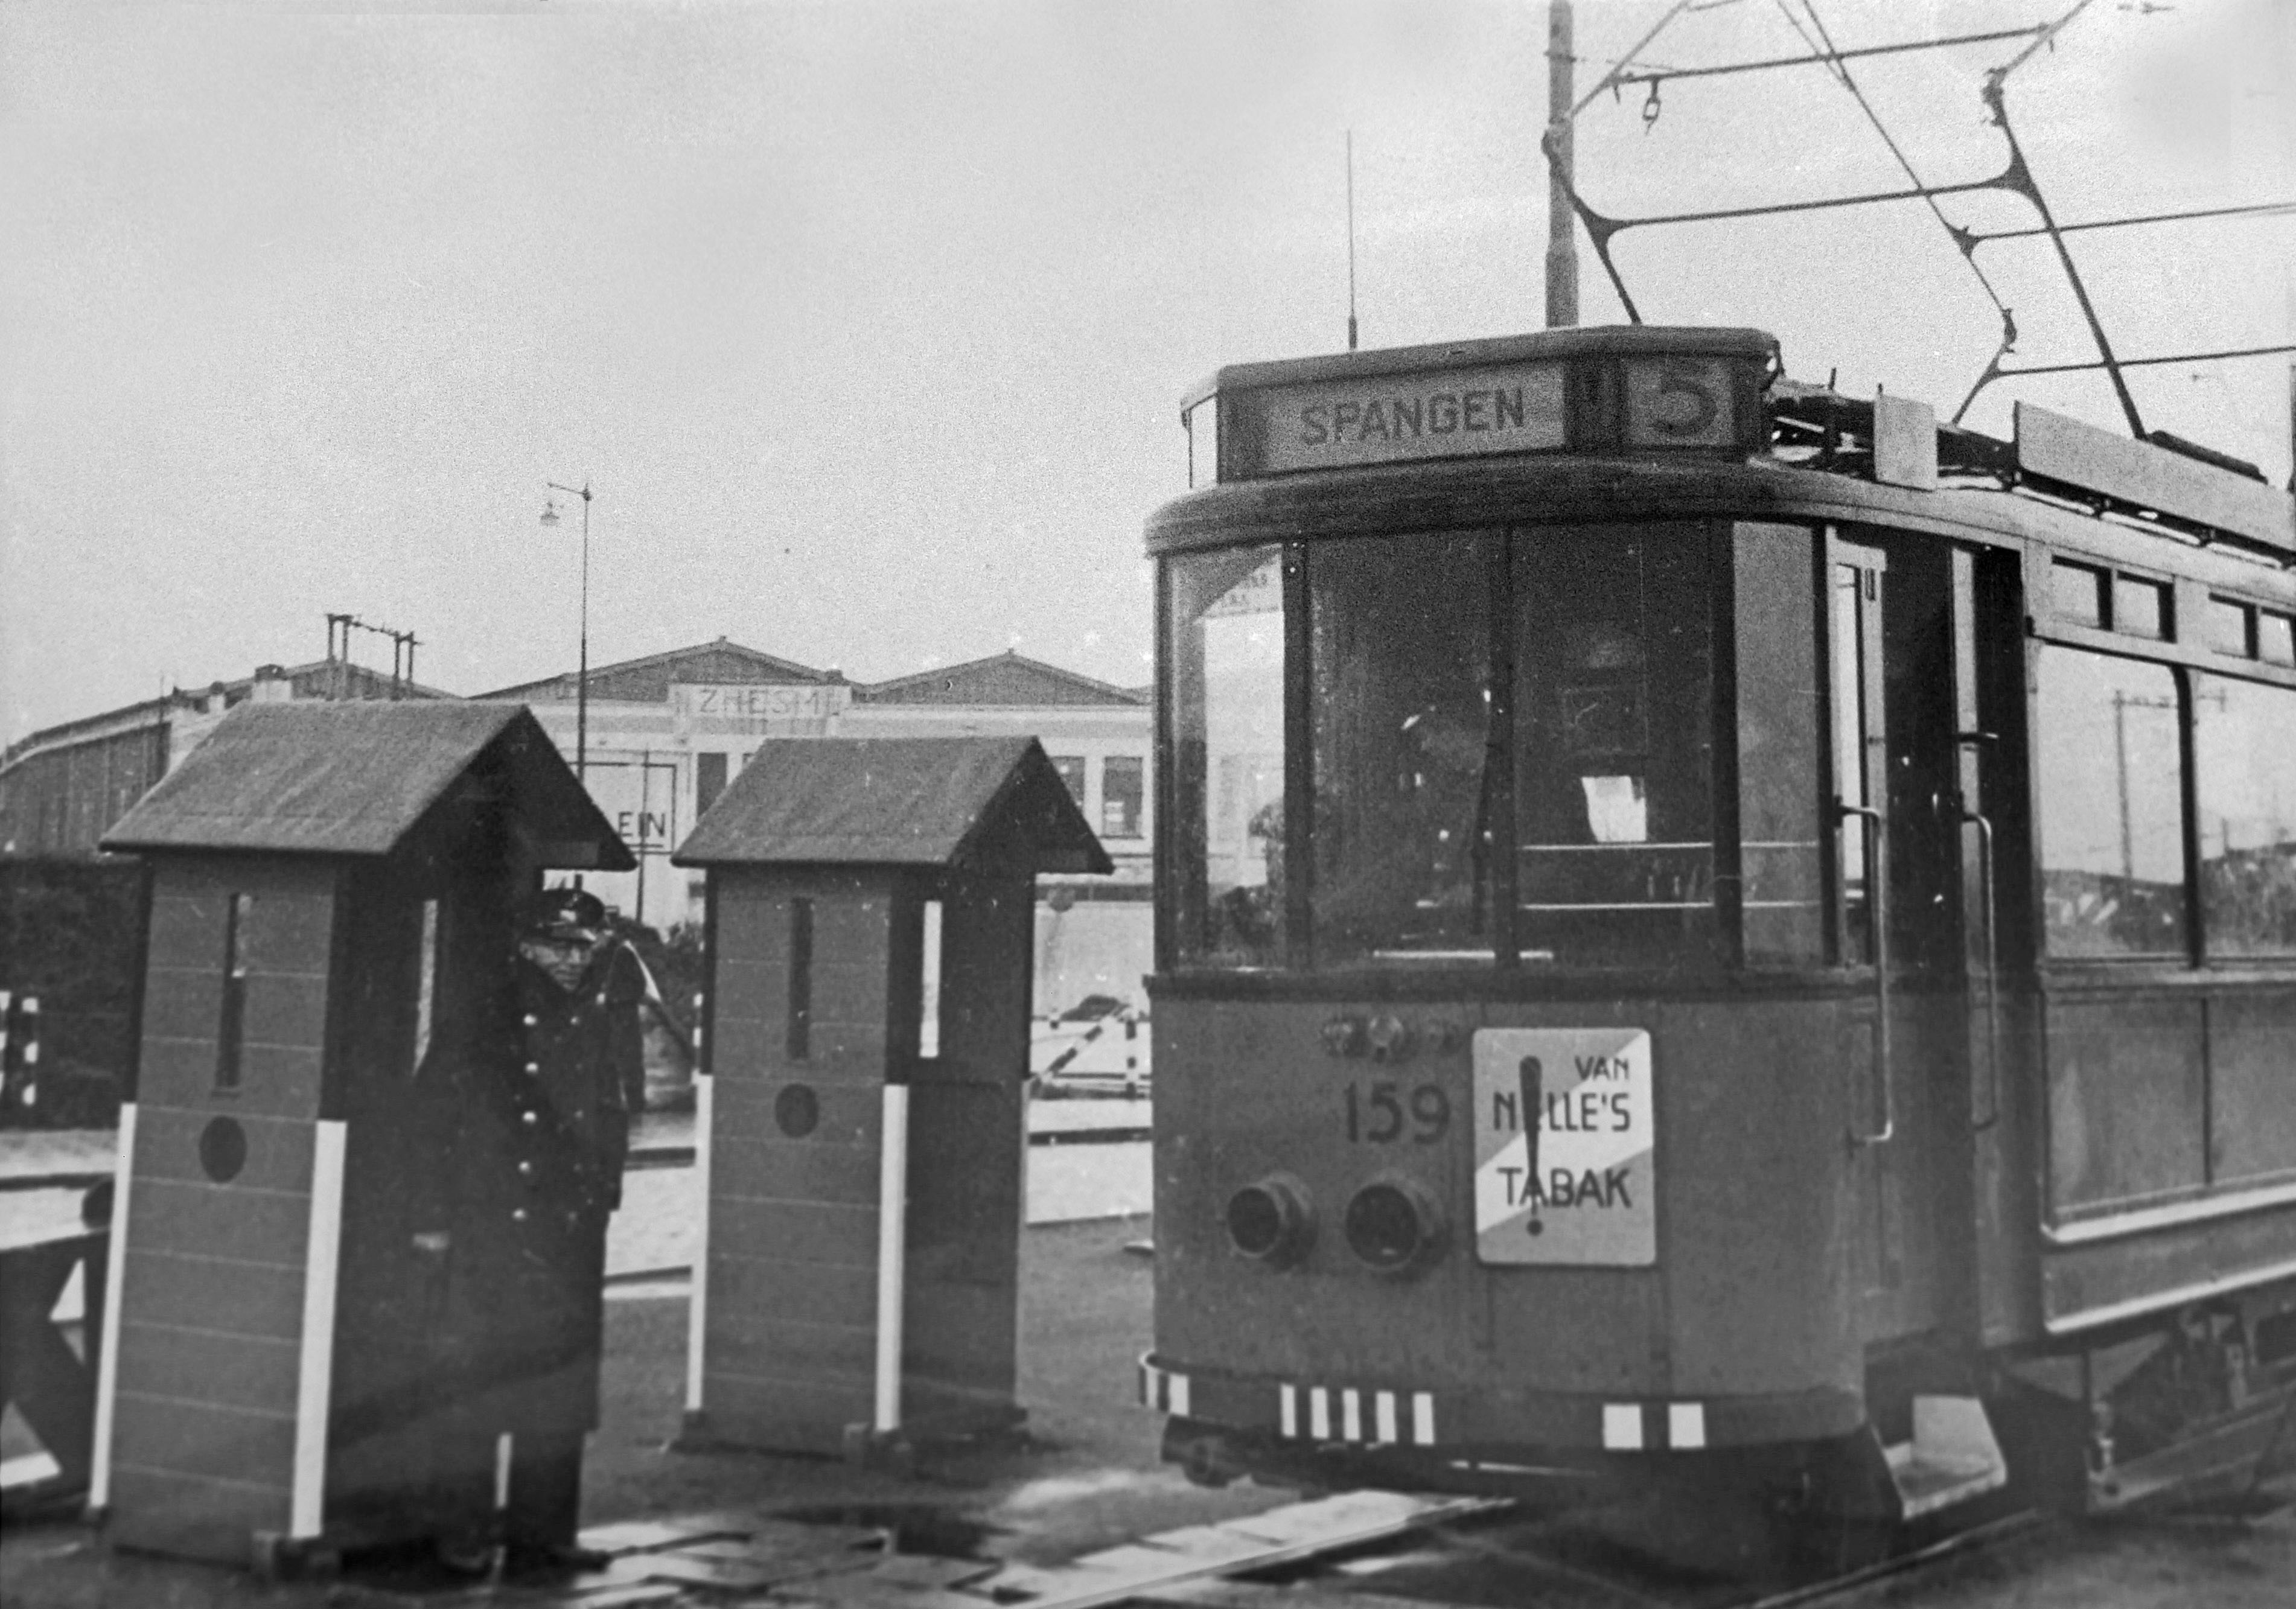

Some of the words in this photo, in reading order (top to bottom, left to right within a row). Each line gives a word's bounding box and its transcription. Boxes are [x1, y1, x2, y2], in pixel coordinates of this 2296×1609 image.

[1300, 386, 1525, 447] SPANGEN
[1651, 377, 1718, 437] 5
[1574, 1055, 1630, 1081] VAN
[1344, 1082, 1450, 1144] 159
[1493, 1091, 1631, 1132] NLLE'S
[1496, 1167, 1633, 1208] TABAK
